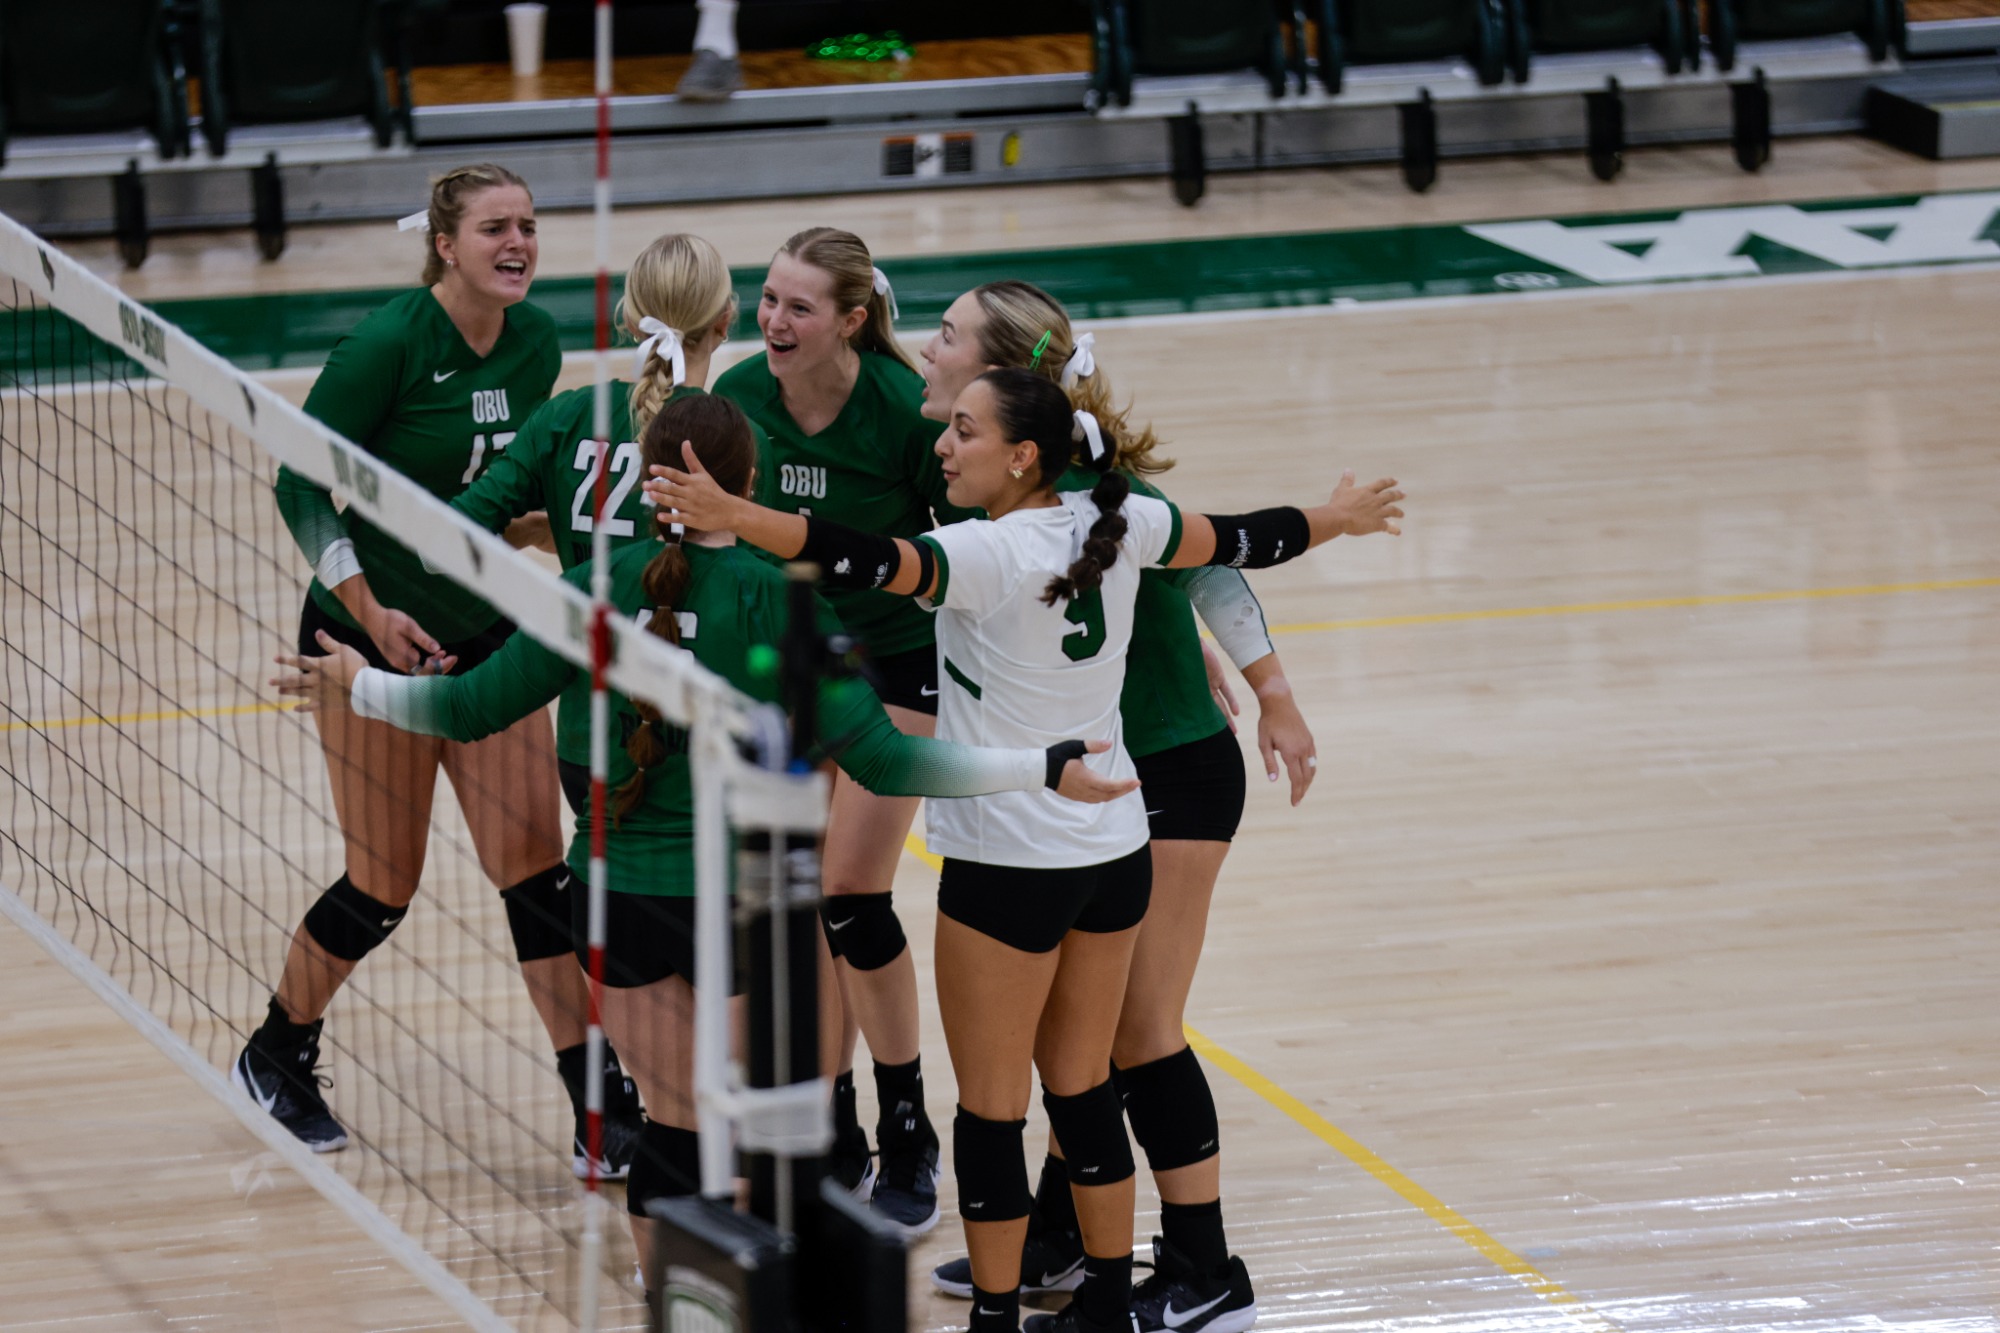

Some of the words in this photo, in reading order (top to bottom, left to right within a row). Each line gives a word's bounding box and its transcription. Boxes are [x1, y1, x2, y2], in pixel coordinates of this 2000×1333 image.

[472, 388, 510, 424] OBU
[571, 438, 643, 537] 22
[780, 463, 827, 500] OBU
